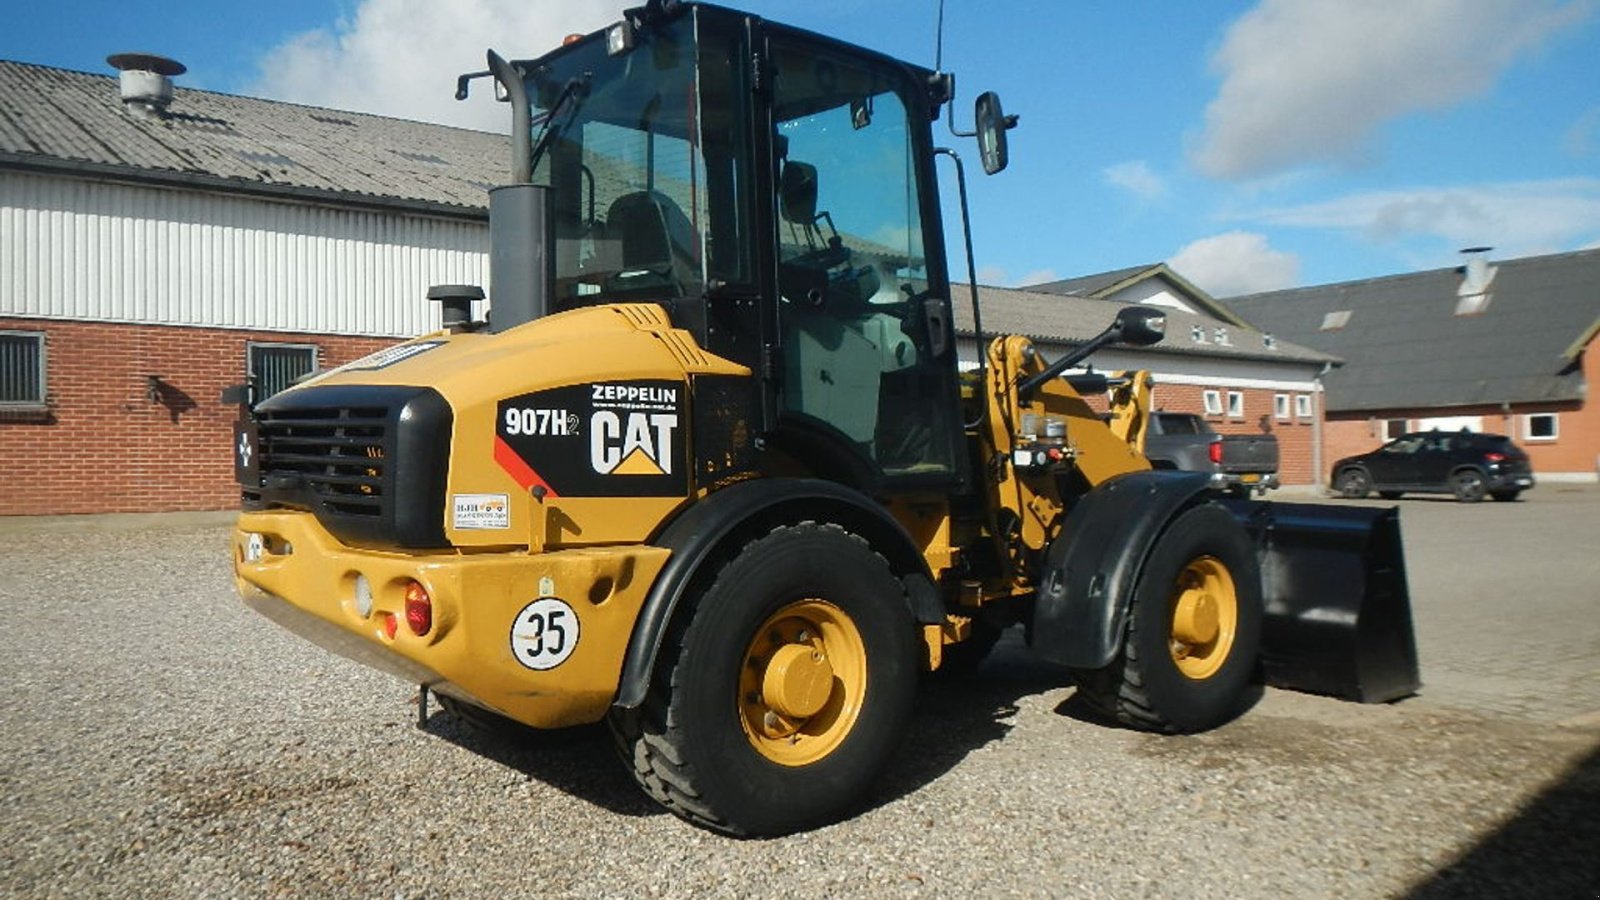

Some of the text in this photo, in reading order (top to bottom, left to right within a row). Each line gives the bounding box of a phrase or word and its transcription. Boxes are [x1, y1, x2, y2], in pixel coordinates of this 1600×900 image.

[592, 384, 676, 403] ZEPPELIN
[591, 410, 677, 475] CAT
[527, 611, 565, 657] 35
